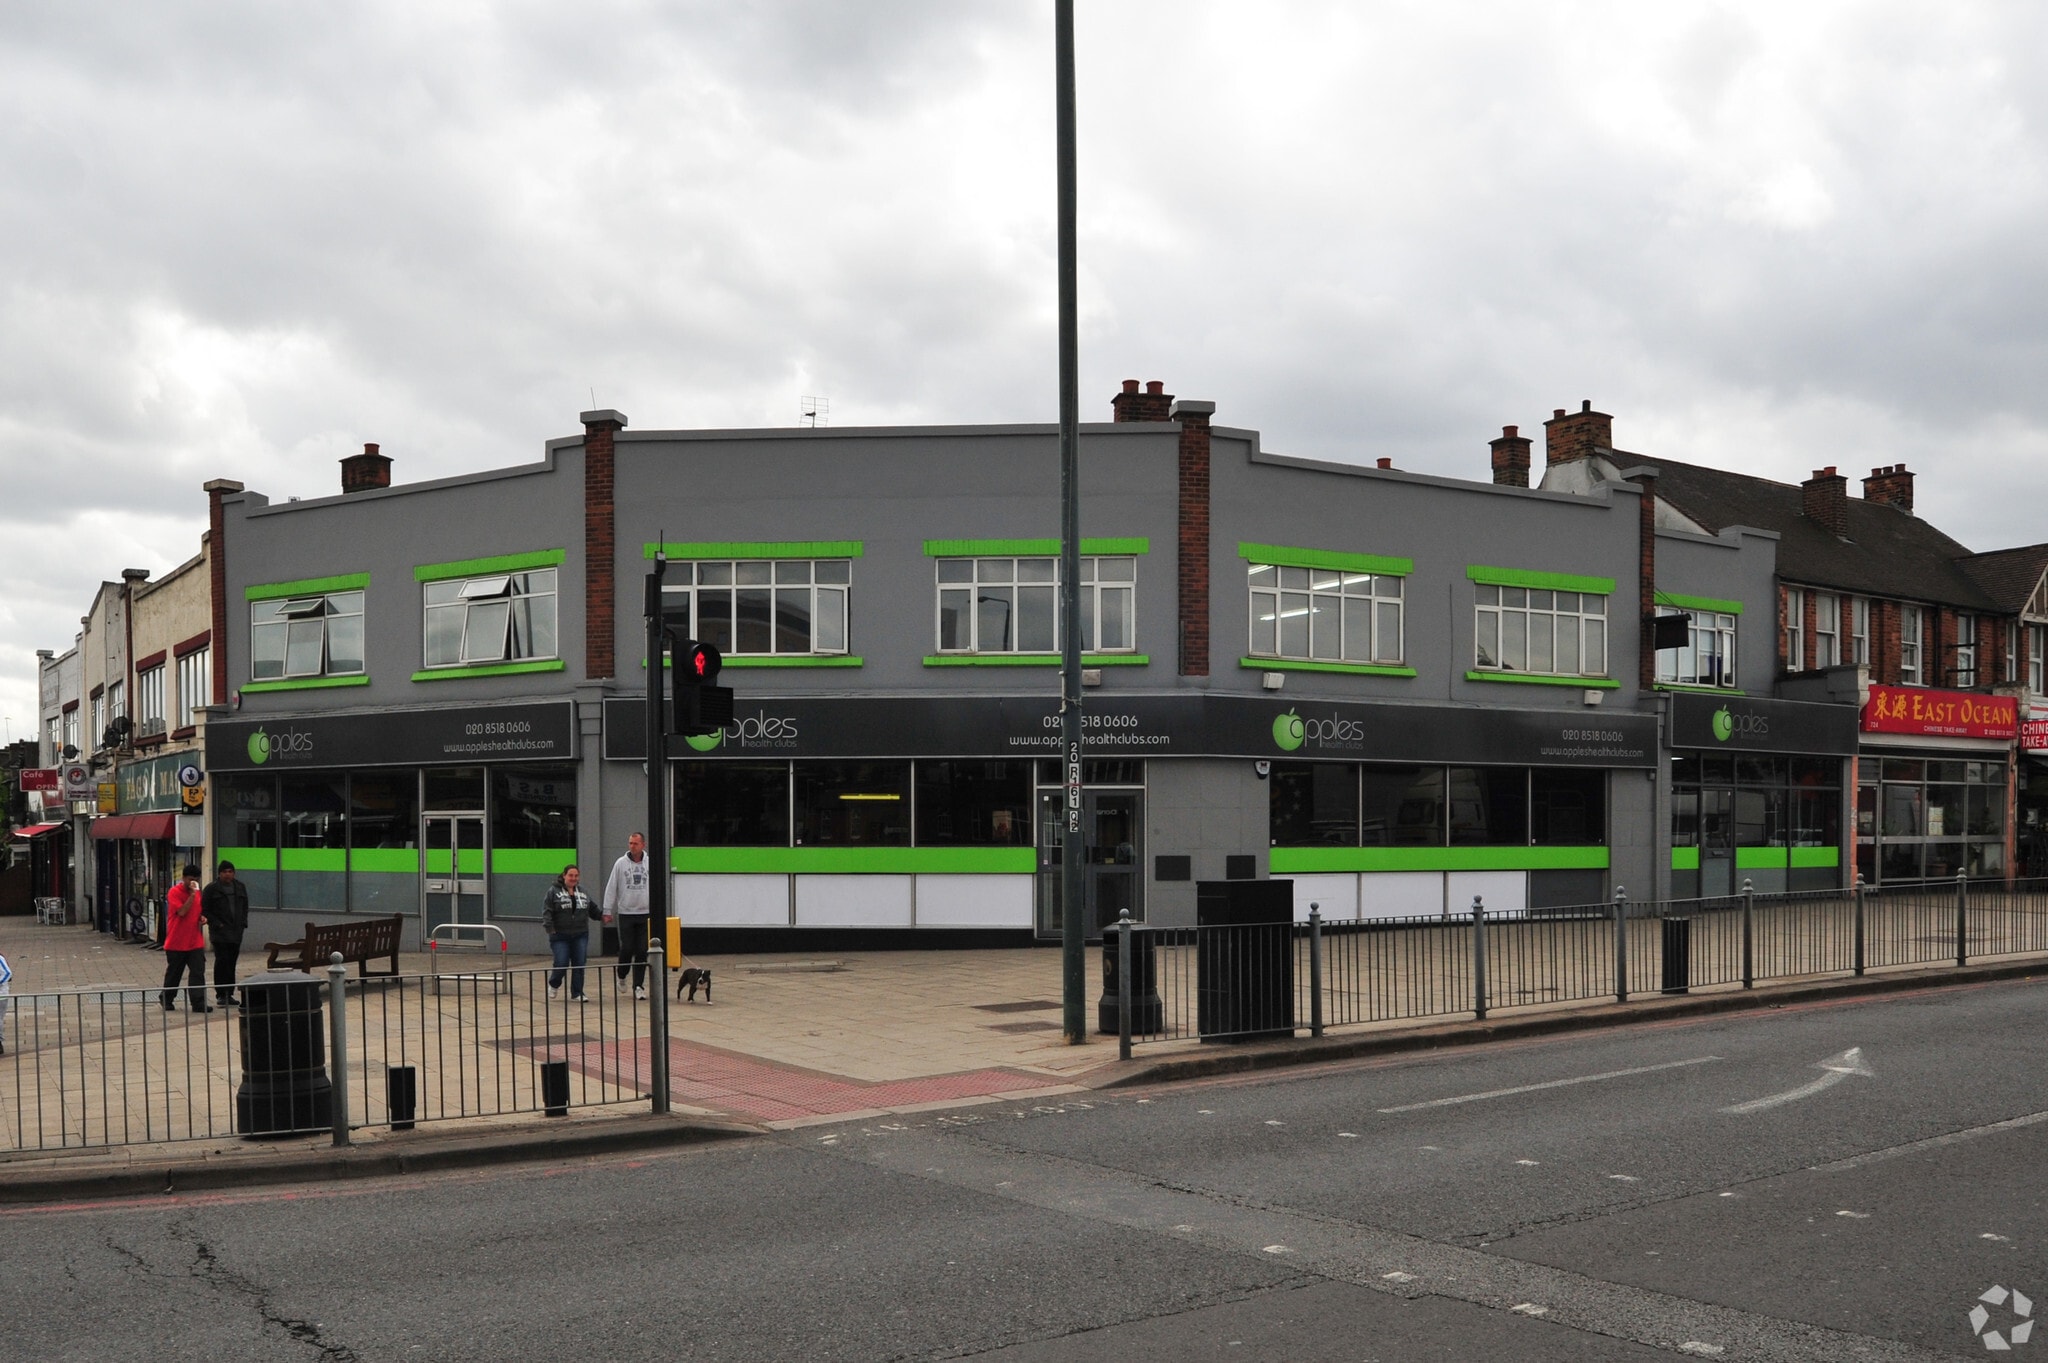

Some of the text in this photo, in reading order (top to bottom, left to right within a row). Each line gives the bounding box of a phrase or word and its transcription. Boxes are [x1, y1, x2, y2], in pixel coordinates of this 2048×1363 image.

[1913, 695, 2013, 725] EAST OCEAN
[465, 720, 531, 735] 020 8518 0606
[708, 709, 798, 748] pples
[1081, 715, 1101, 728] 518
[1103, 714, 1138, 728] 0606
[1290, 711, 1364, 748] apples
[1562, 729, 1624, 742] 020 8518 0606
[260, 726, 313, 760] apples
[745, 739, 798, 748] health clubs
[1009, 732, 1170, 748] www.apphealthclubs.com
